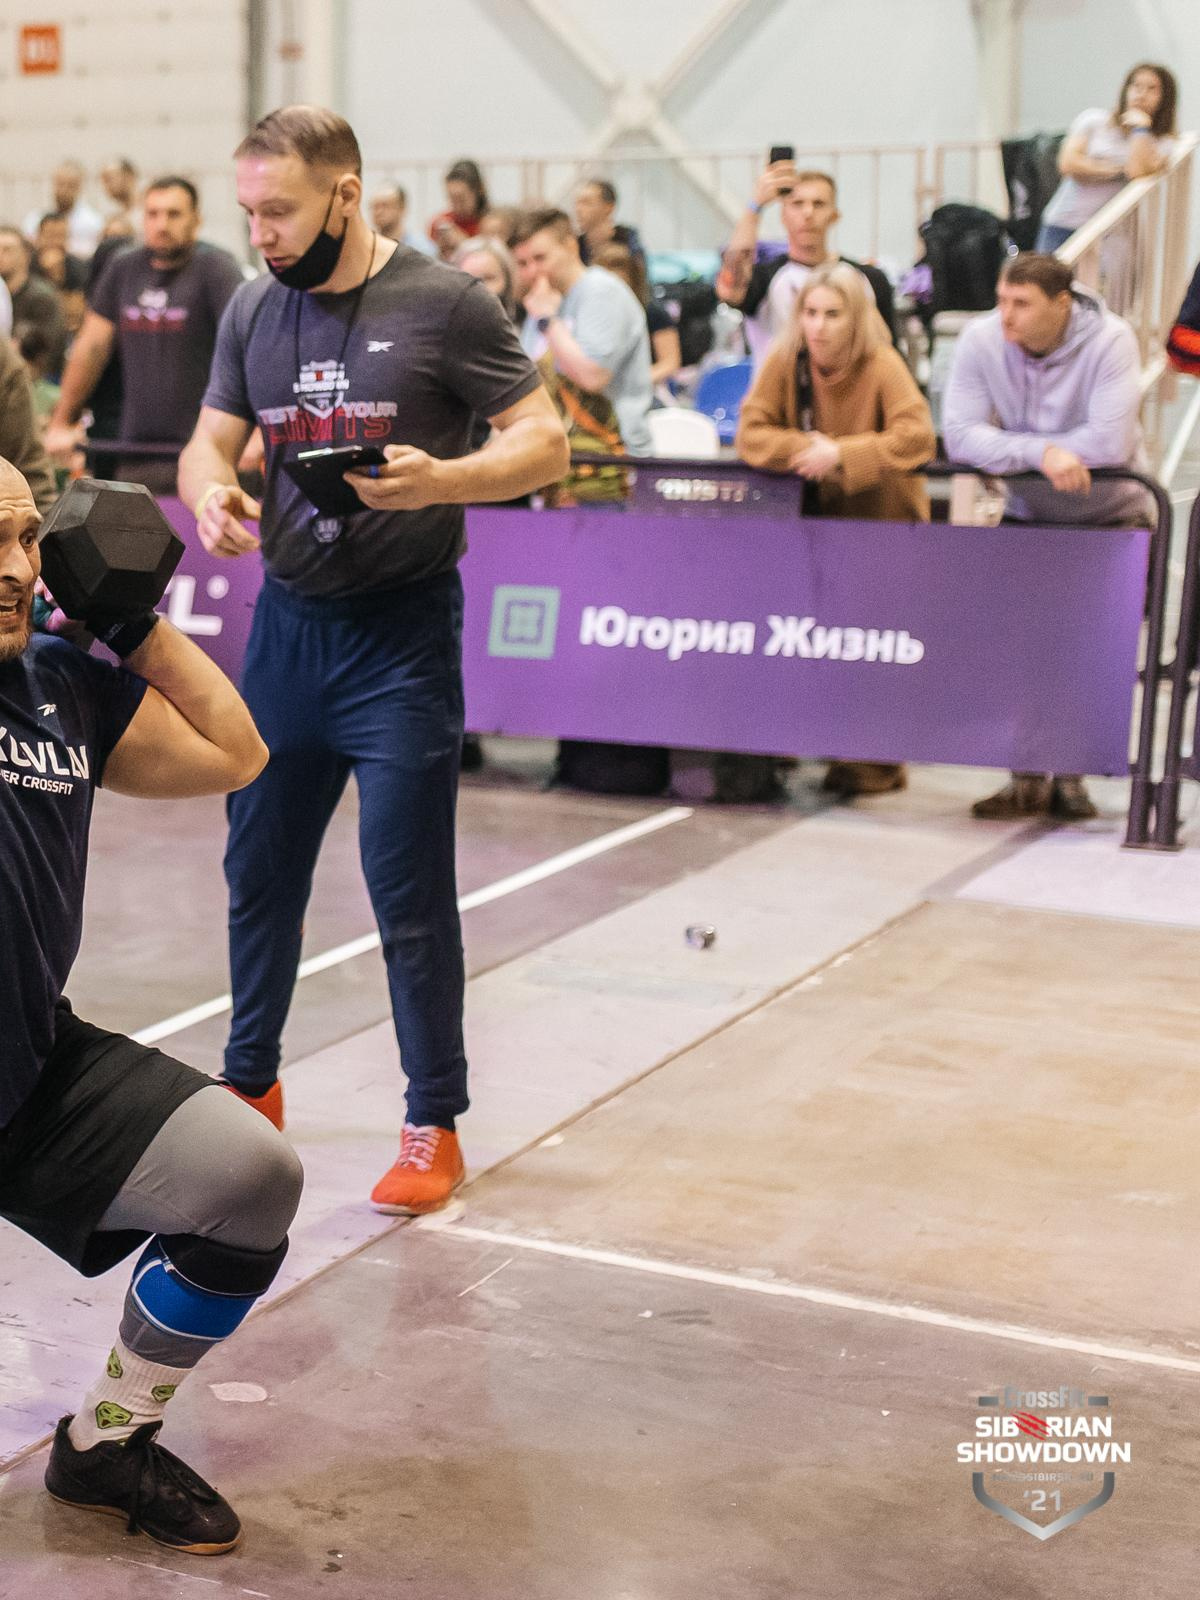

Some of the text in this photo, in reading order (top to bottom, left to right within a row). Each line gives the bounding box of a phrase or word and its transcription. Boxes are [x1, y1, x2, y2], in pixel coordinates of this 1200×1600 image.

[341, 402, 398, 419] YOUR
[579, 606, 925, 664] Югория Жизнь
[22, 775, 74, 796] CROSSFIT
